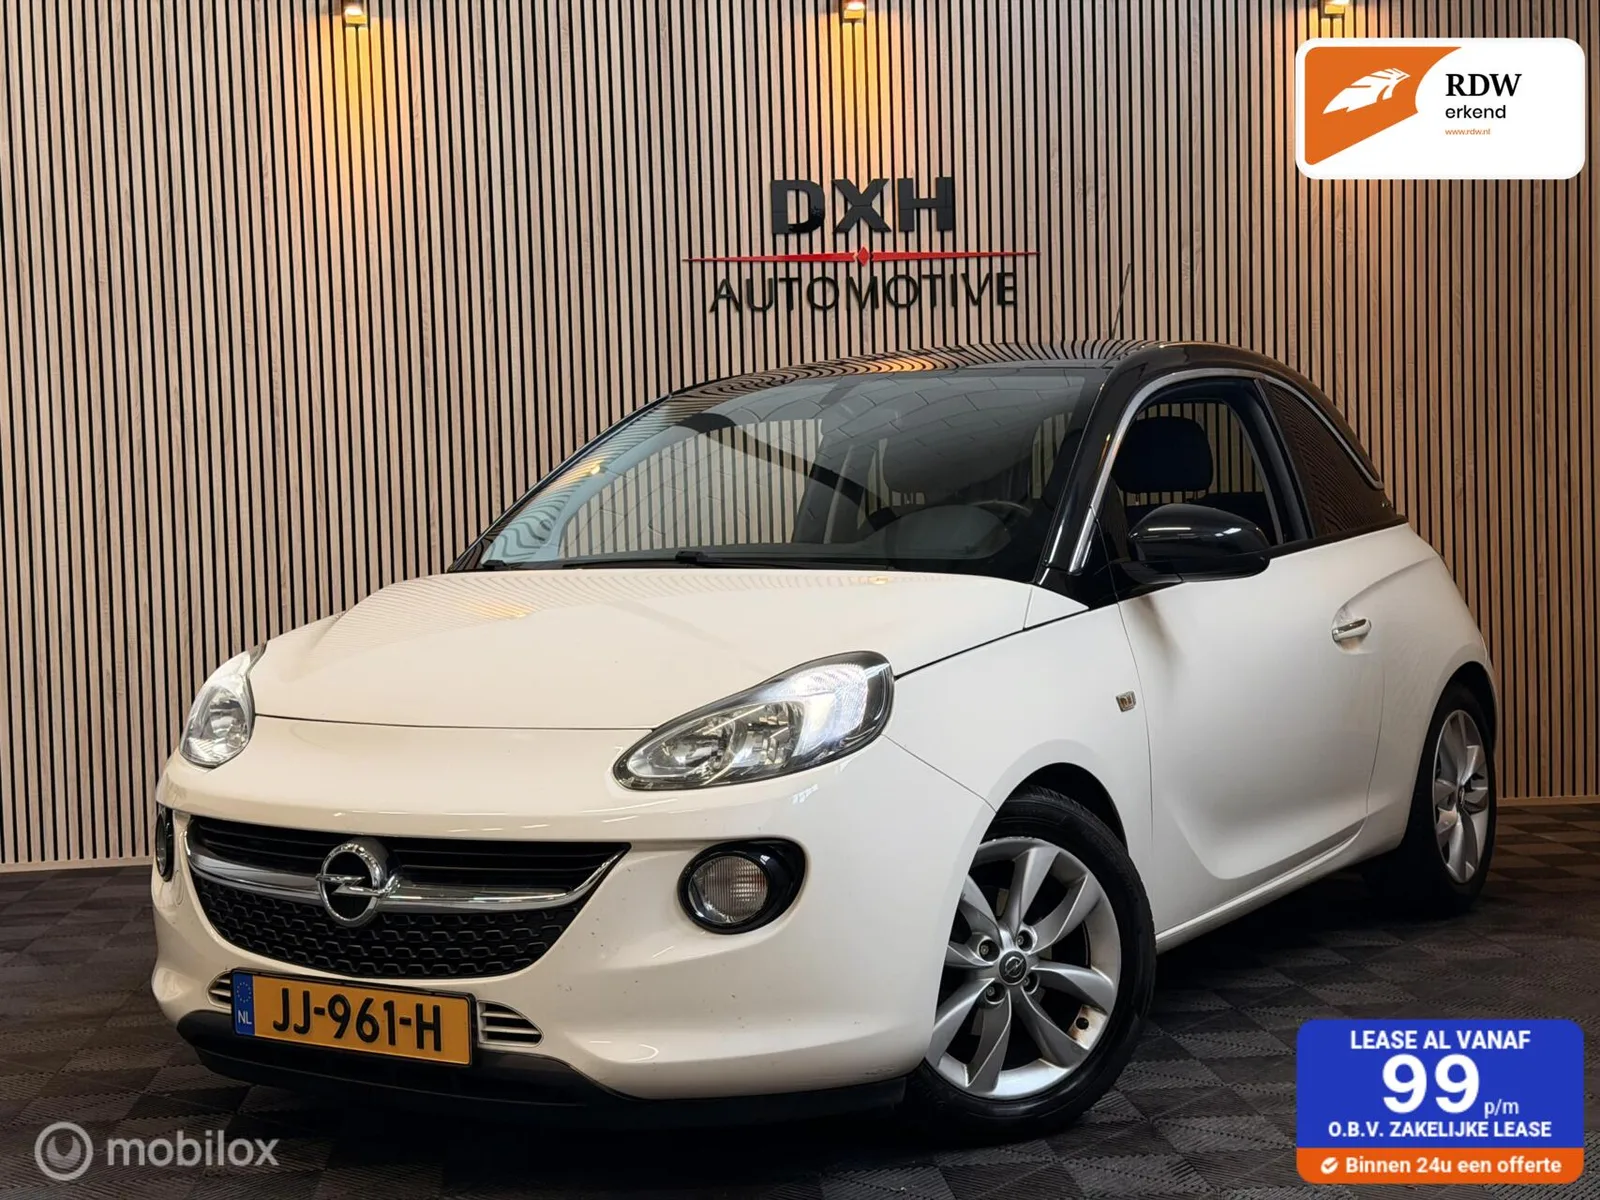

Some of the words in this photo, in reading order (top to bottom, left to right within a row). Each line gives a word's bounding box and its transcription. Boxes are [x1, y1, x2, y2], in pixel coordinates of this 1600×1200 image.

[770, 176, 953, 235] DXH
[709, 271, 1018, 313] AUTOMOTIVE
[237, 1009, 252, 1026] NL
[272, 987, 442, 1052] JJ-961-H
